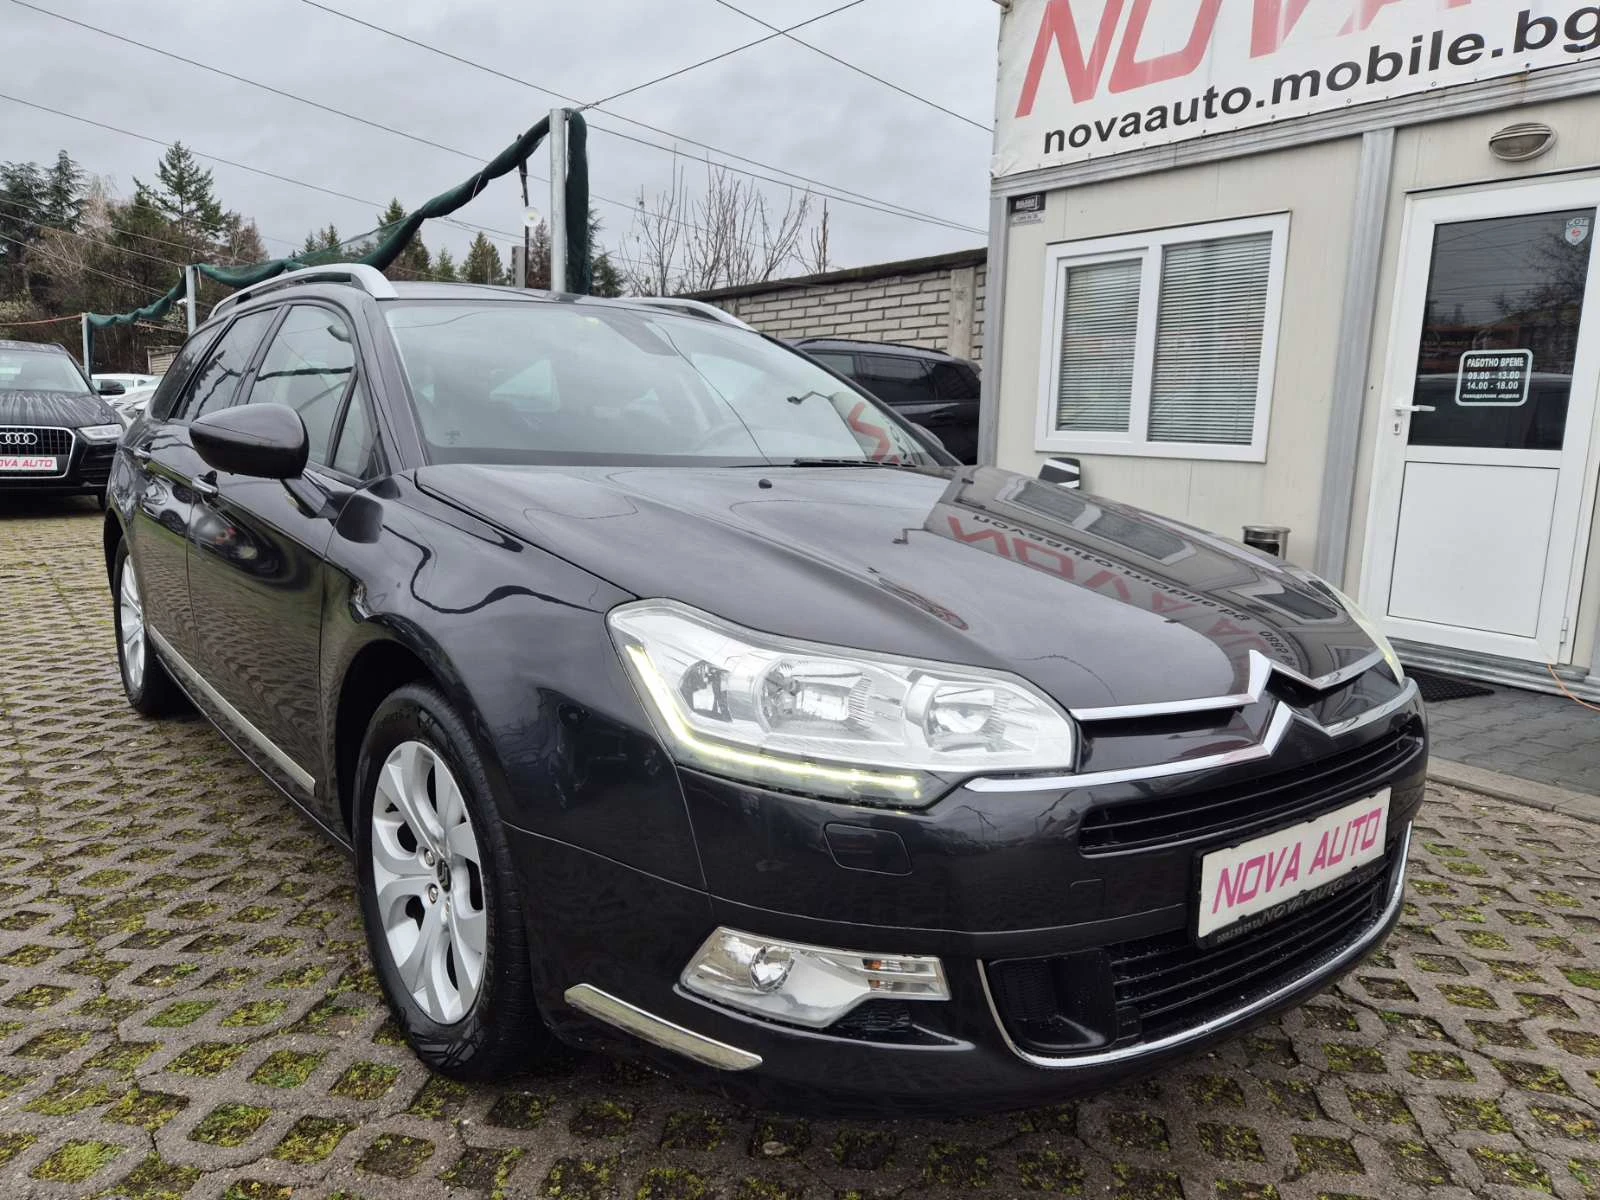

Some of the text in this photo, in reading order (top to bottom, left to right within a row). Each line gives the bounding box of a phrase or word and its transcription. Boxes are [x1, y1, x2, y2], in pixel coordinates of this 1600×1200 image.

[1043, 6, 1600, 154] novaauto.mobile.bg
[1467, 356, 1525, 368] РАБОТНО ВРЕМЕ
[1467, 381, 1489, 390] 14.00
[1496, 380, 1519, 390] 18.00
[22, 459, 53, 468] AUTO
[1212, 807, 1382, 915] NOVA AUTO
